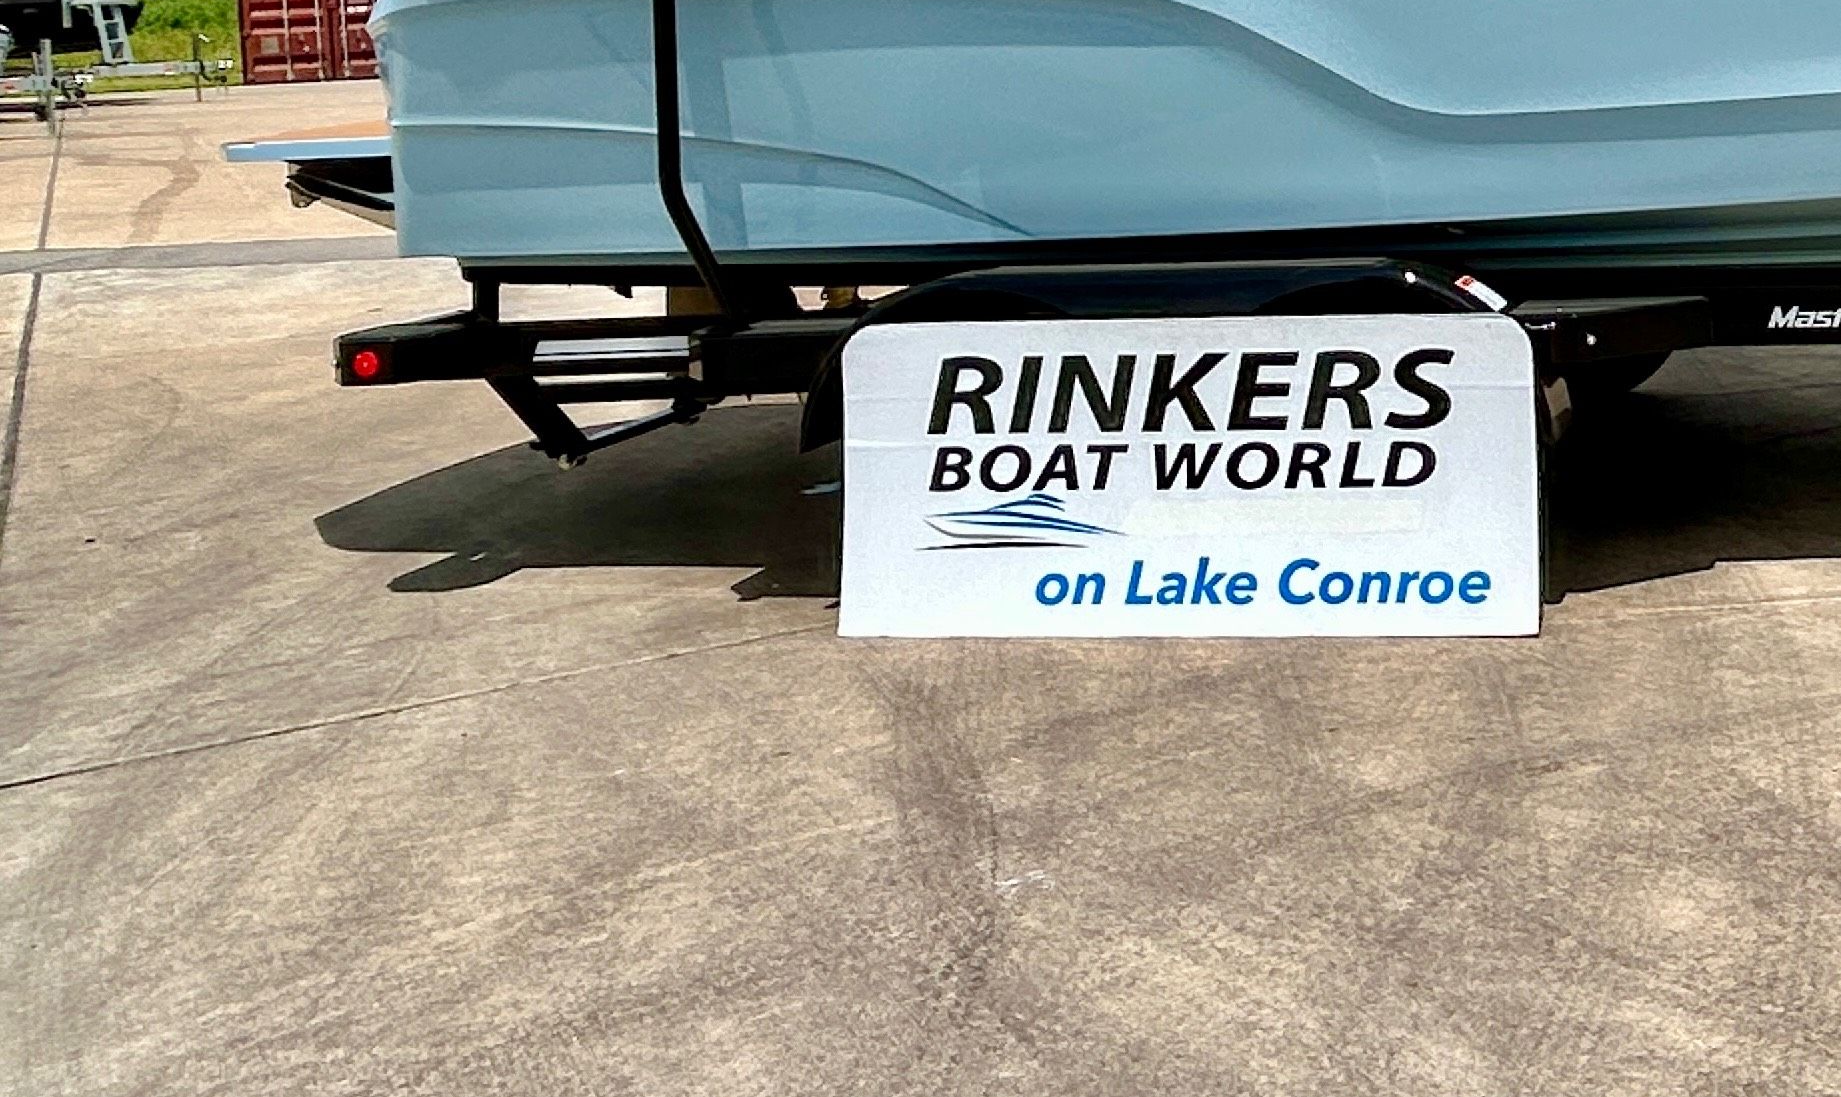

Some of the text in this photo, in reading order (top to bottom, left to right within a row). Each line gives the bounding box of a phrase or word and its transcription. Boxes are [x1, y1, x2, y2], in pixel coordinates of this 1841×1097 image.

[927, 349, 1454, 434] RINKERS
[929, 442, 1436, 492] BOAT WORLD
[1036, 557, 1490, 605] on Lake Conroe
